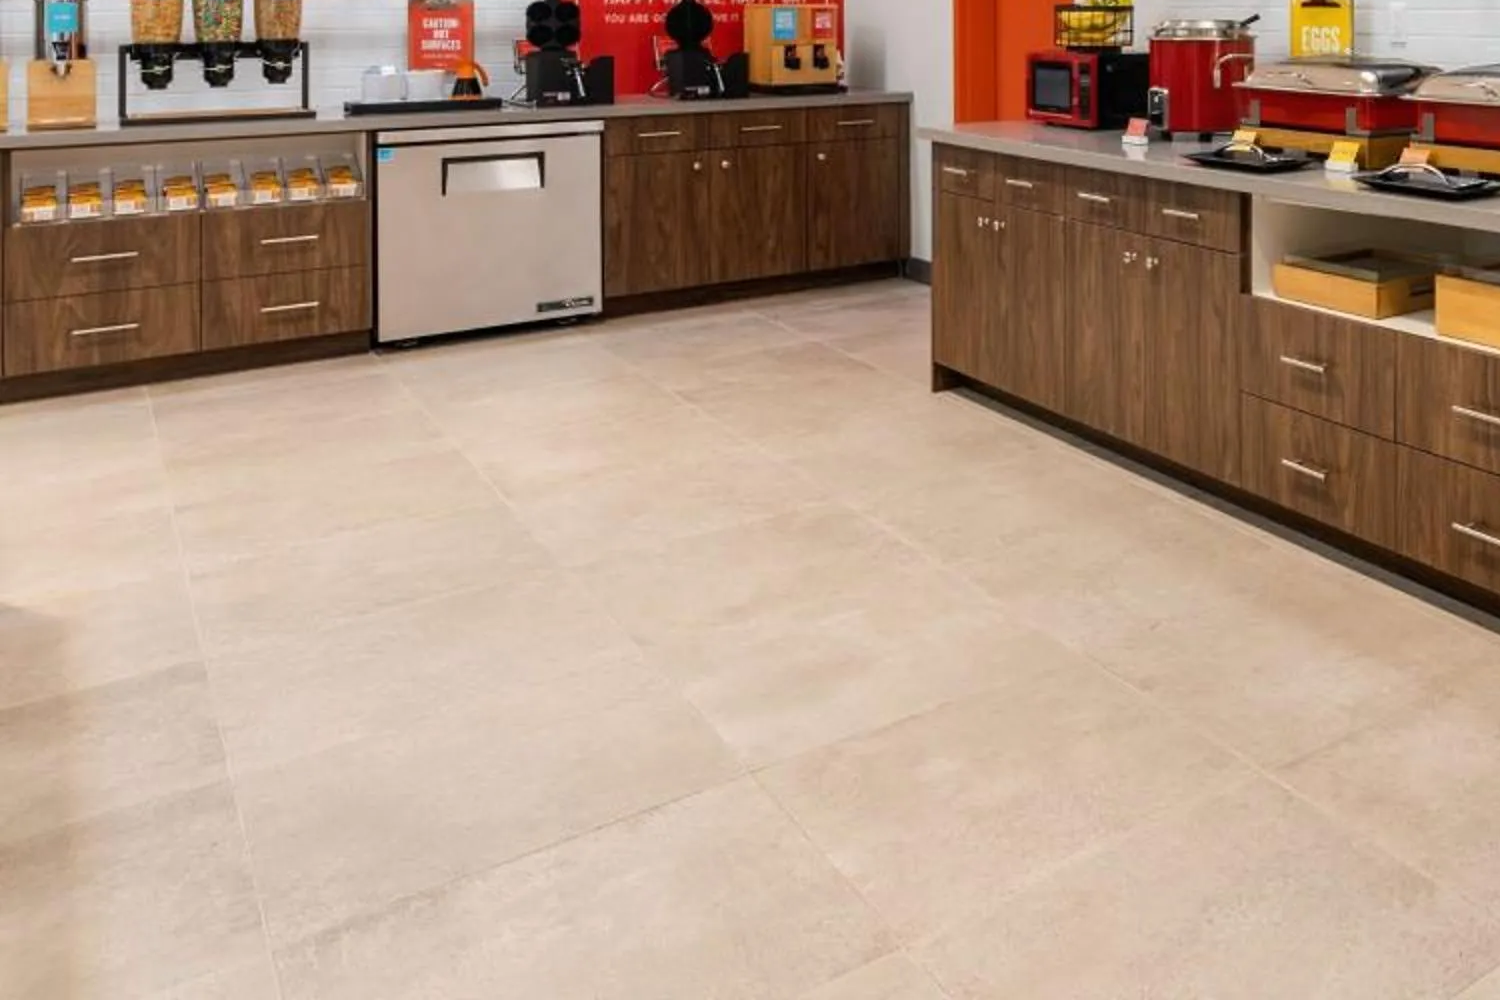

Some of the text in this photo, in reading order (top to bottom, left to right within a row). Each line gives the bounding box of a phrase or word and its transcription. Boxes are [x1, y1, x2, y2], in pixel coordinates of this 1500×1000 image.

[604, 13, 626, 24] YOU
[629, 13, 650, 24] ARE
[433, 29, 449, 39] HOT
[1301, 24, 1341, 53] EGGS
[421, 39, 462, 51] SURFACES
